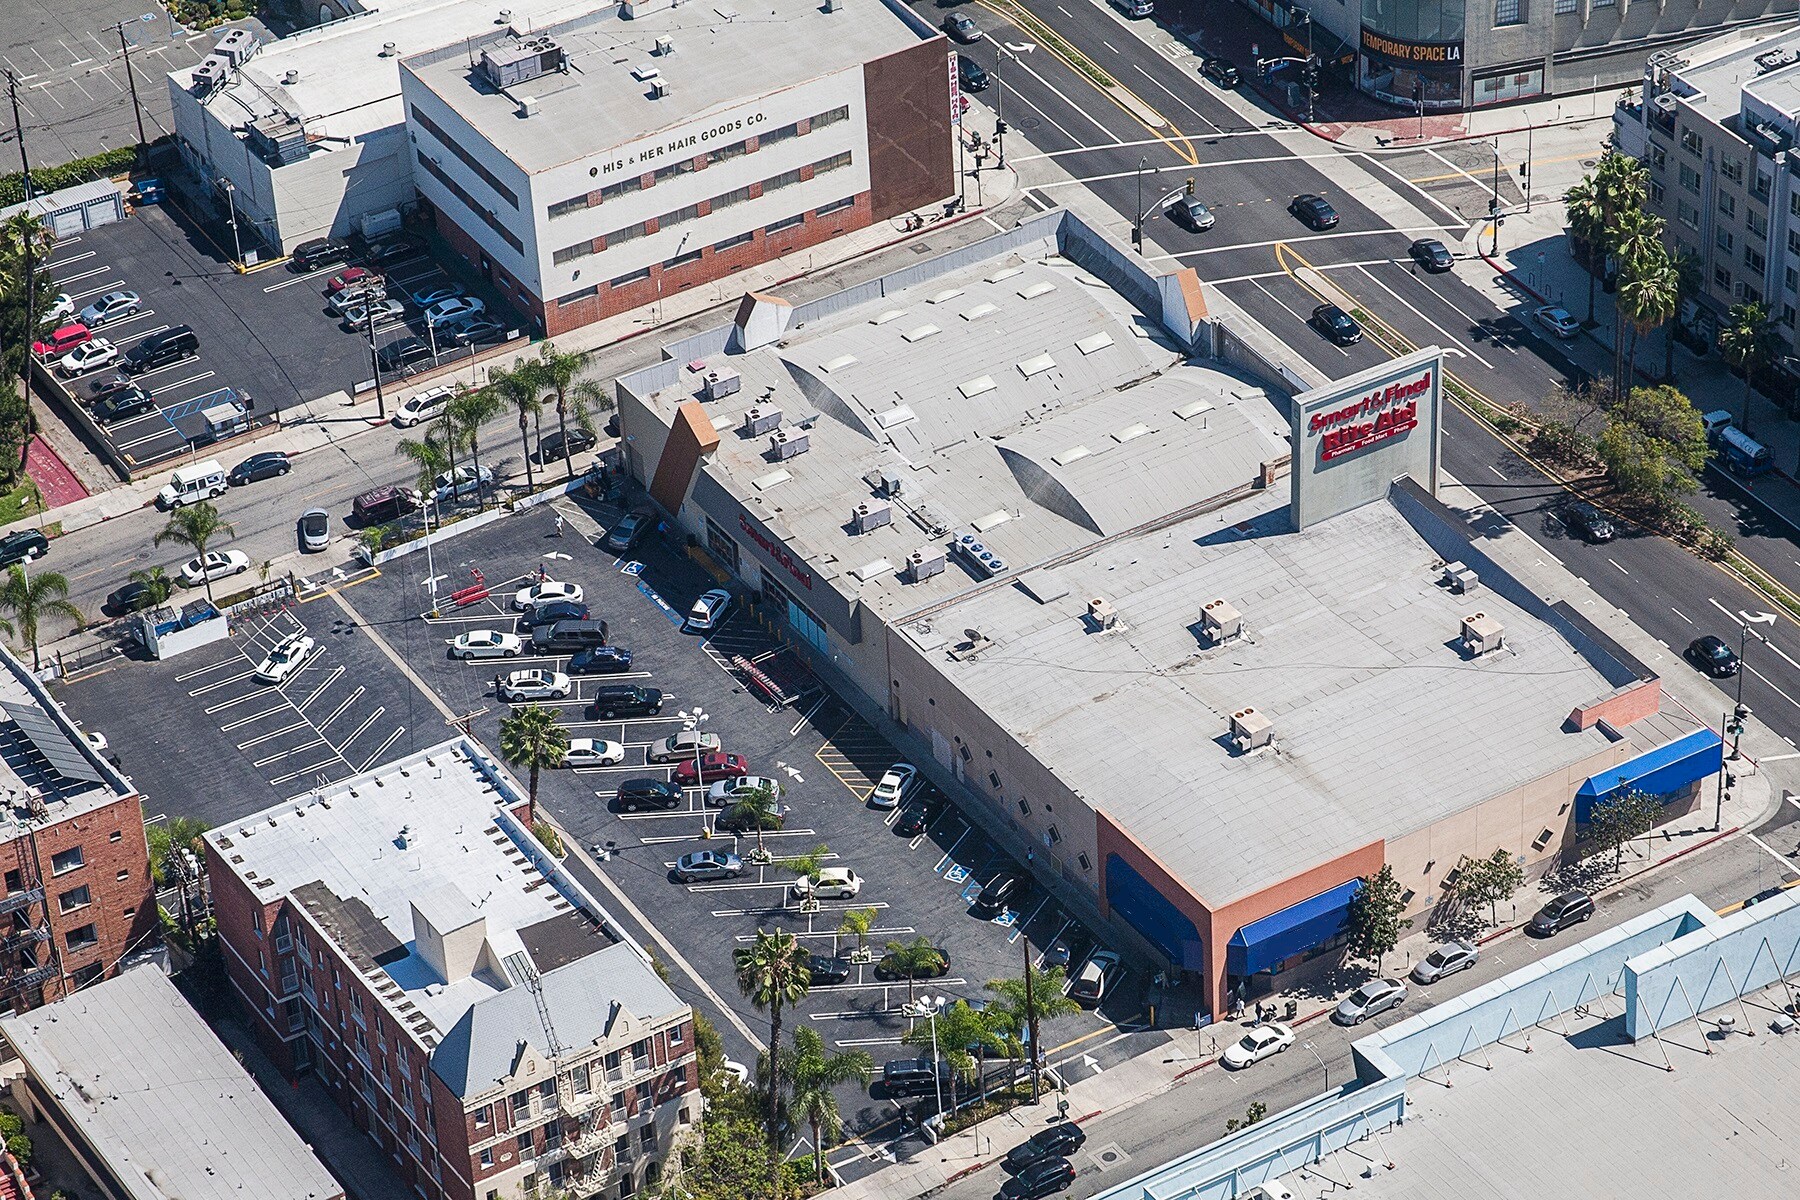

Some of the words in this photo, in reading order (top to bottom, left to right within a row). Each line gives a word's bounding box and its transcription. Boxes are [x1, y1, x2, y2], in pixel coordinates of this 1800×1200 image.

[1362, 30, 1411, 59] TEMPORARY
[1413, 46, 1445, 61] SPACE
[1447, 46, 1460, 60] LA
[602, 159, 623, 174] HIS
[628, 157, 635, 165] &
[639, 146, 664, 162] HER
[668, 135, 697, 152] HAIR
[701, 119, 742, 141] GOODS
[746, 113, 767, 126] CO.
[1322, 421, 1375, 450] Rite
[1376, 400, 1417, 431] Aid
[1331, 445, 1356, 458] Pharmacy
[1361, 438, 1375, 446] Food
[1375, 432, 1388, 441] Mart
[1393, 425, 1410, 434] Photo
